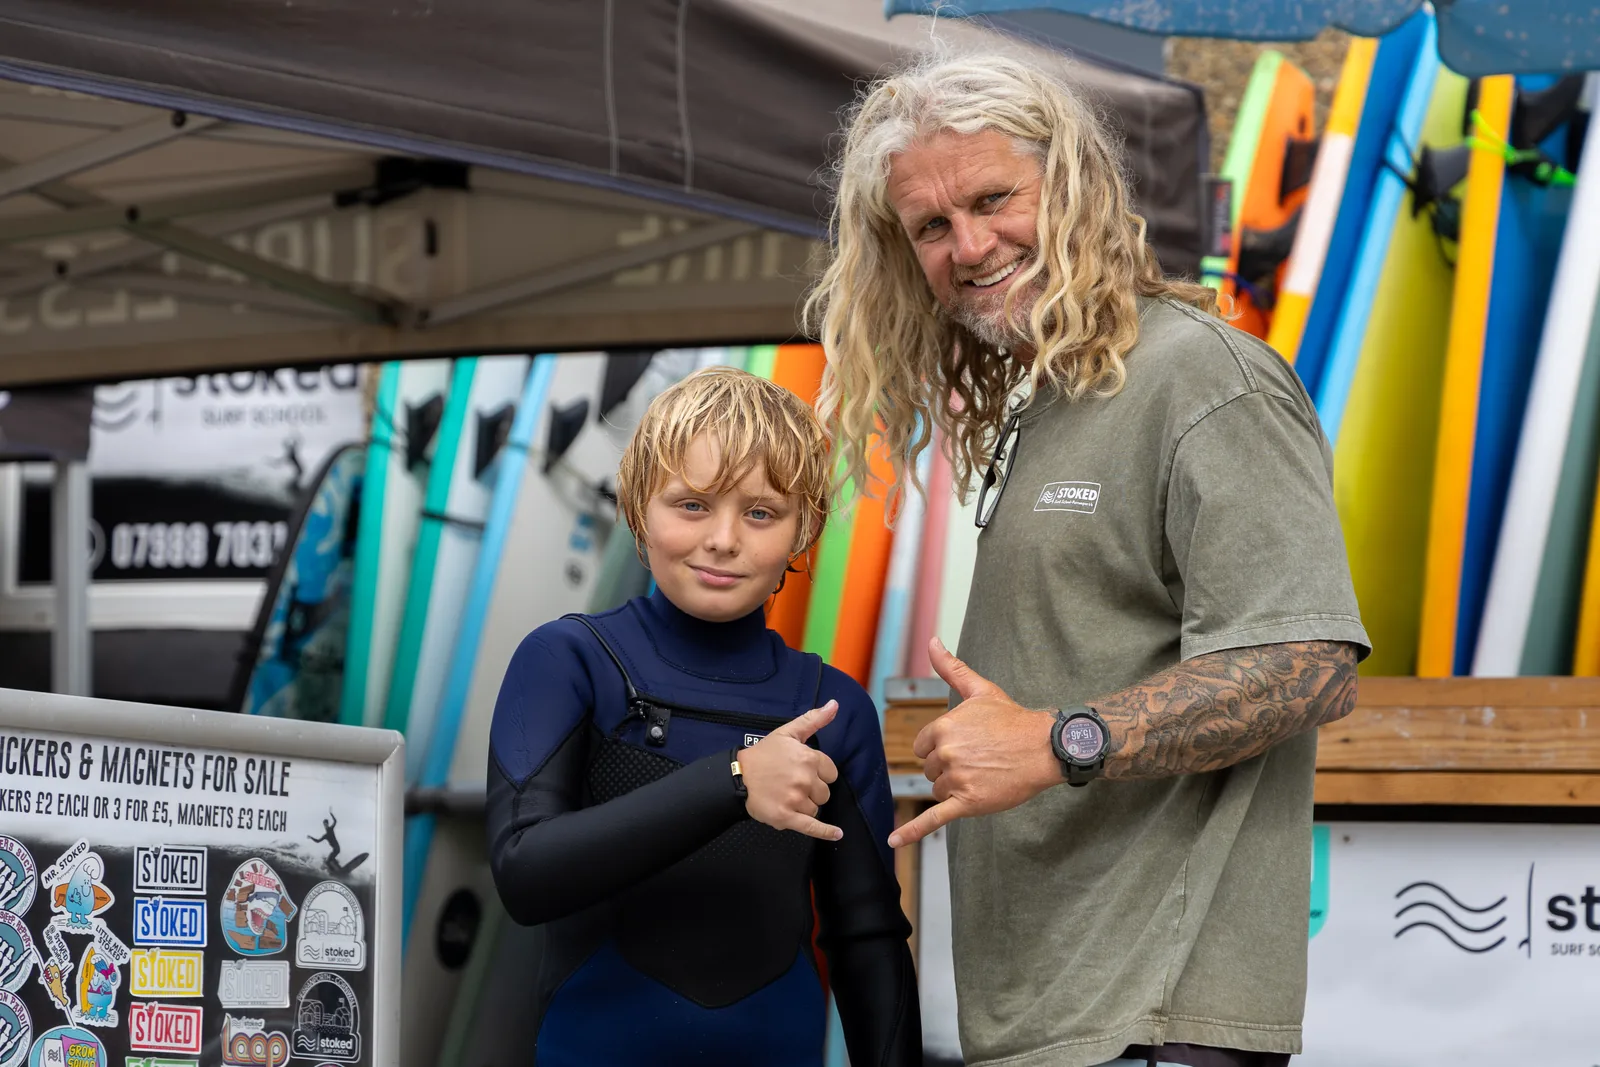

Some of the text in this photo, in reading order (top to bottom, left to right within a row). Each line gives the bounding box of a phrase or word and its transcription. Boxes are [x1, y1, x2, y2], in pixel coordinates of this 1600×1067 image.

[1057, 487, 1097, 501] STOKED
[0, 735, 291, 797] ICKERS & MAGNETS FOR SALE
[0, 788, 287, 832] KERS £2 EACH OR 3 FOR £5, MAGNETS £3 EACH
[16, 847, 34, 874] SUCK
[44, 841, 86, 884] MR. STOKED
[142, 847, 198, 884] STOKED
[141, 898, 198, 937] STOKED
[95, 925, 113, 945] LITTLE
[112, 942, 128, 960] MISS
[98, 936, 121, 961] STOKED
[324, 946, 355, 957] stoked
[1551, 943, 1584, 956] SURF
[138, 949, 195, 988] STOKED
[224, 962, 281, 999] STOKED
[135, 1004, 193, 1044] STOKED
[68, 1044, 97, 1059] GROM
[320, 1036, 353, 1050] stoked
